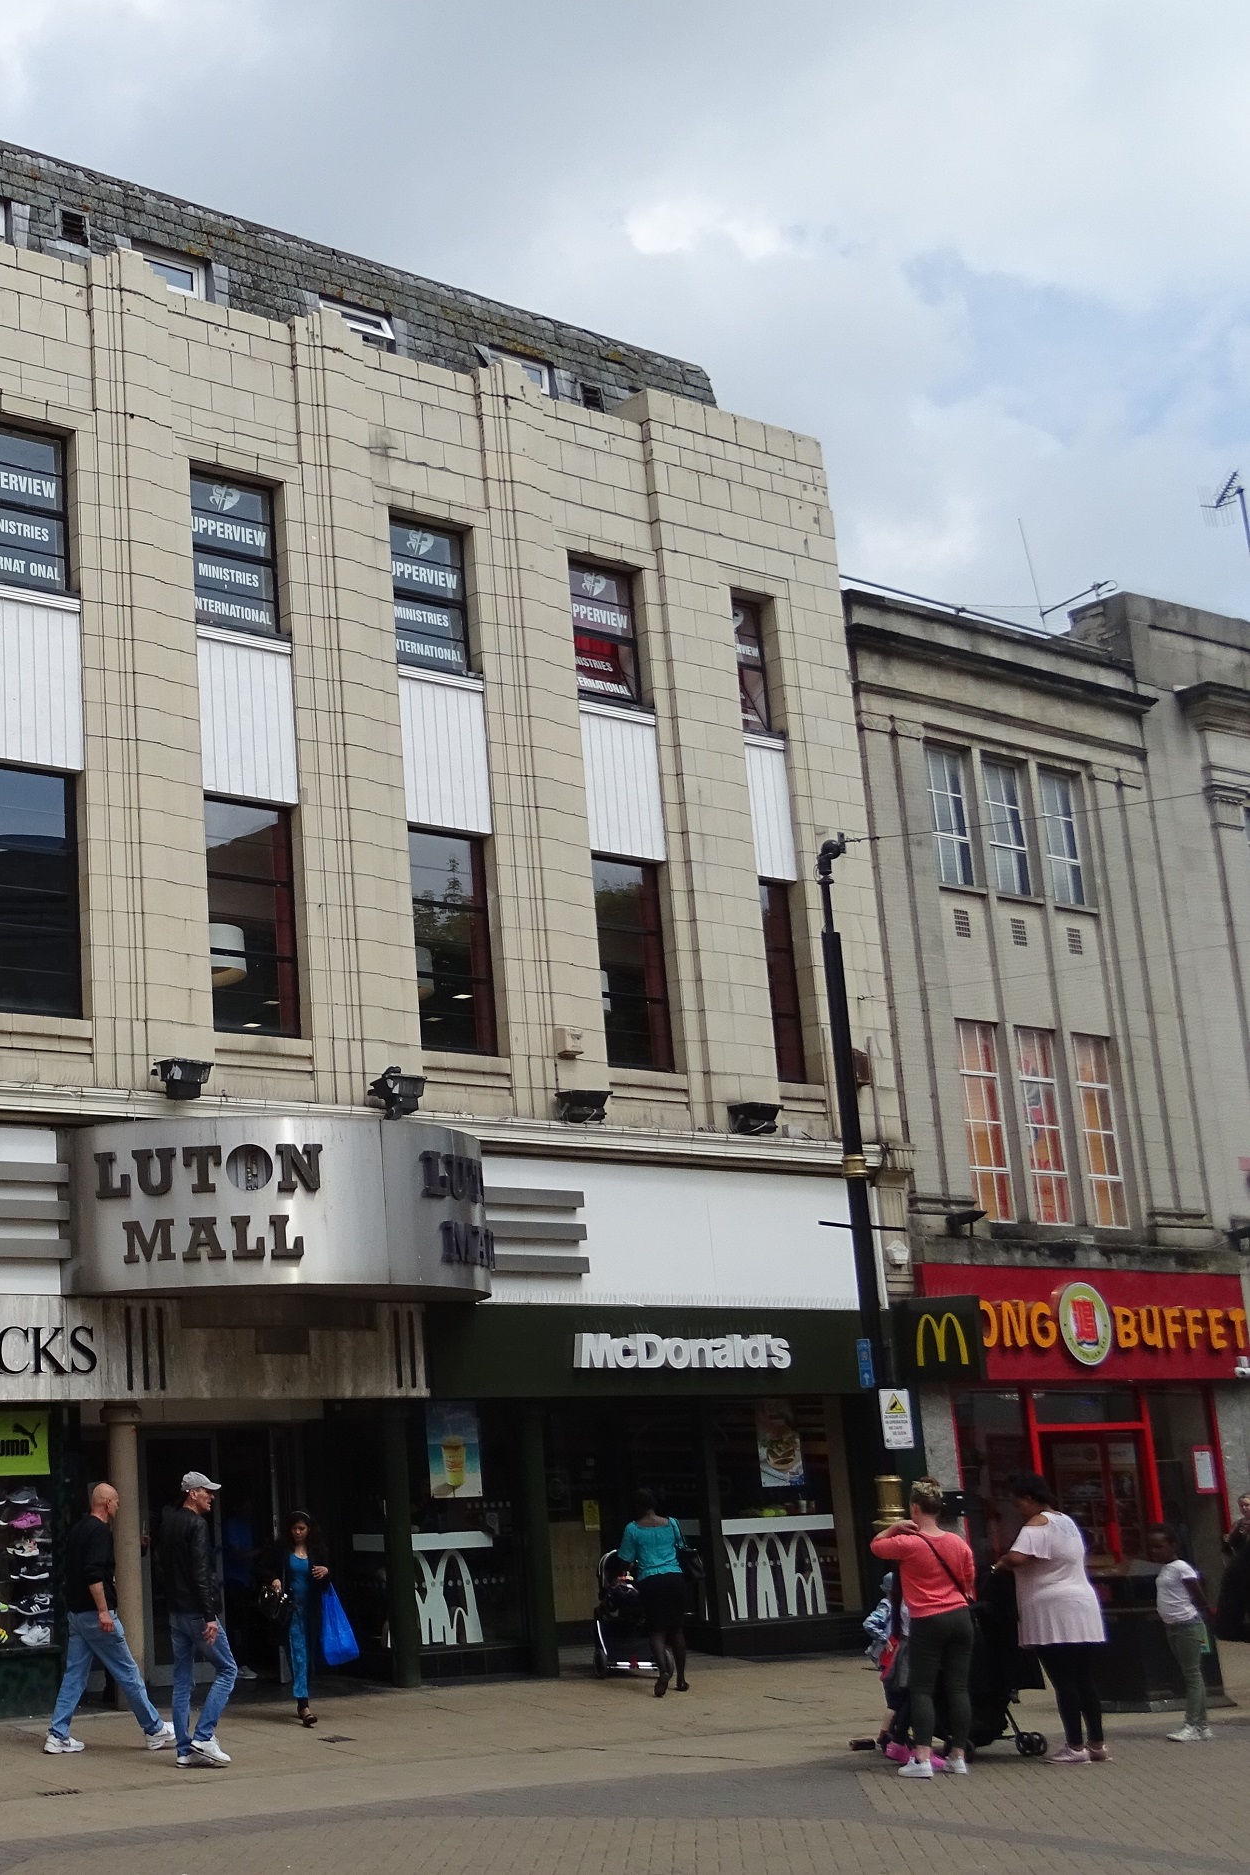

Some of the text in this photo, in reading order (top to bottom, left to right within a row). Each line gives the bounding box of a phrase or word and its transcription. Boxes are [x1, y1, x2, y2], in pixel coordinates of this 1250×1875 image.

[198, 562, 259, 588] MINISTRIES
[93, 1143, 323, 1200] LUTON
[121, 1214, 305, 1264] MALL
[1112, 1305, 1246, 1350] BUFFET
[573, 1333, 792, 1369] McDonald's
